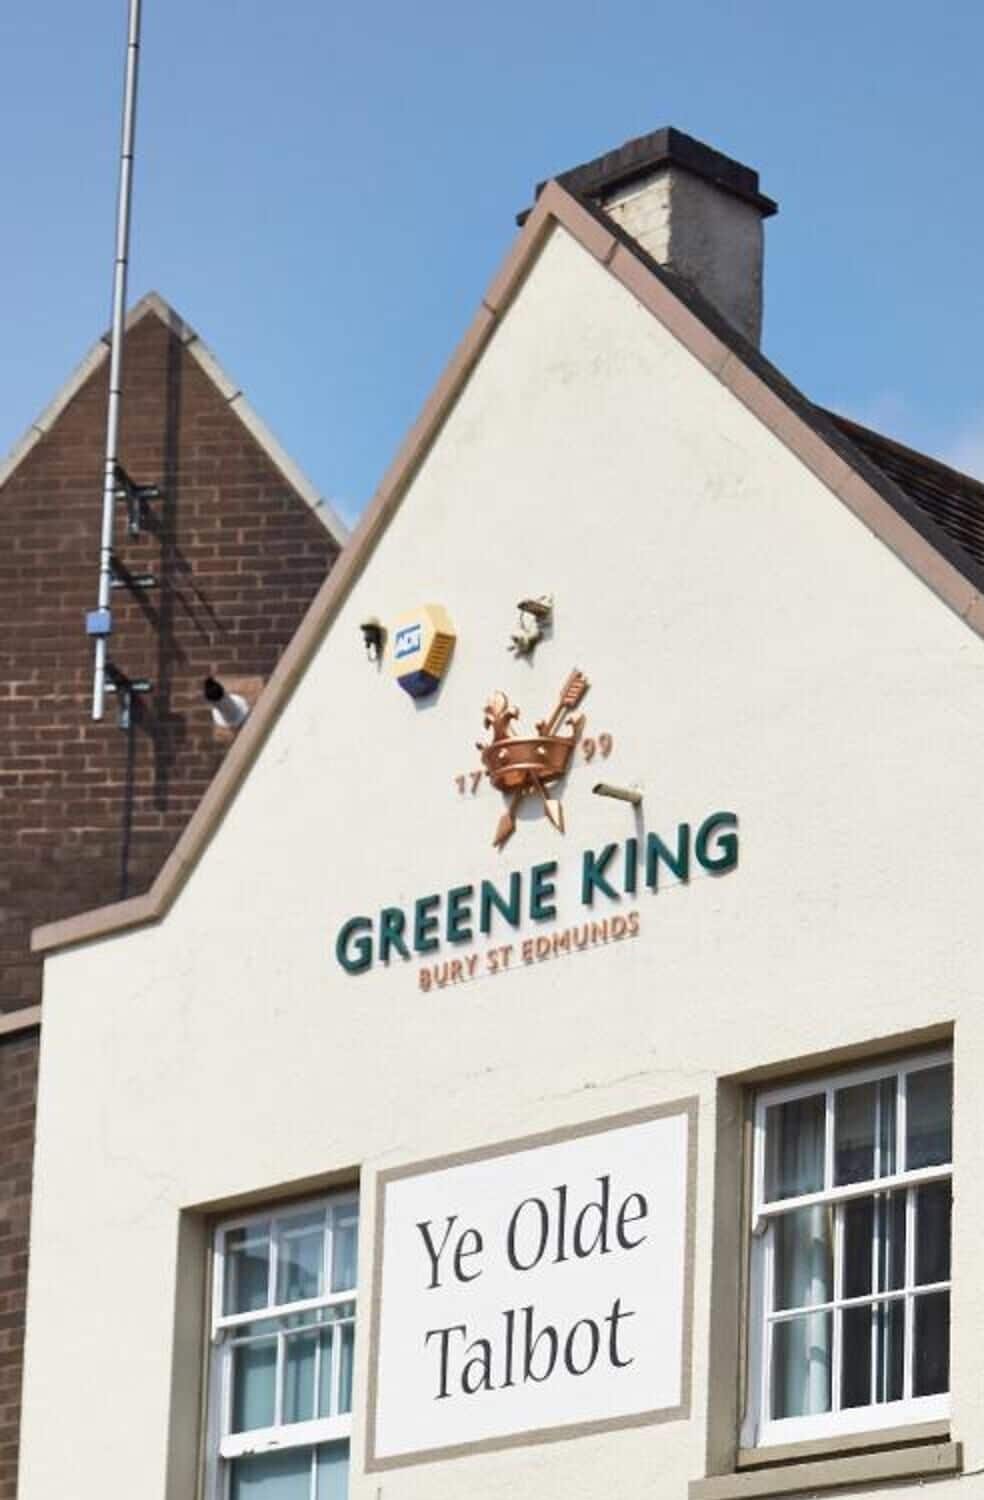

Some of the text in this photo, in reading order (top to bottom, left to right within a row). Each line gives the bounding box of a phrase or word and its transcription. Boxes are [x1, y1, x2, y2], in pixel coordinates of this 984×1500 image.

[455, 733, 613, 795] 17 99
[335, 811, 740, 975] GREENE KING
[418, 911, 641, 992] BURY ST EDMUNDS
[416, 1173, 649, 1290] Ye Olde
[424, 1297, 637, 1400] Talbot
